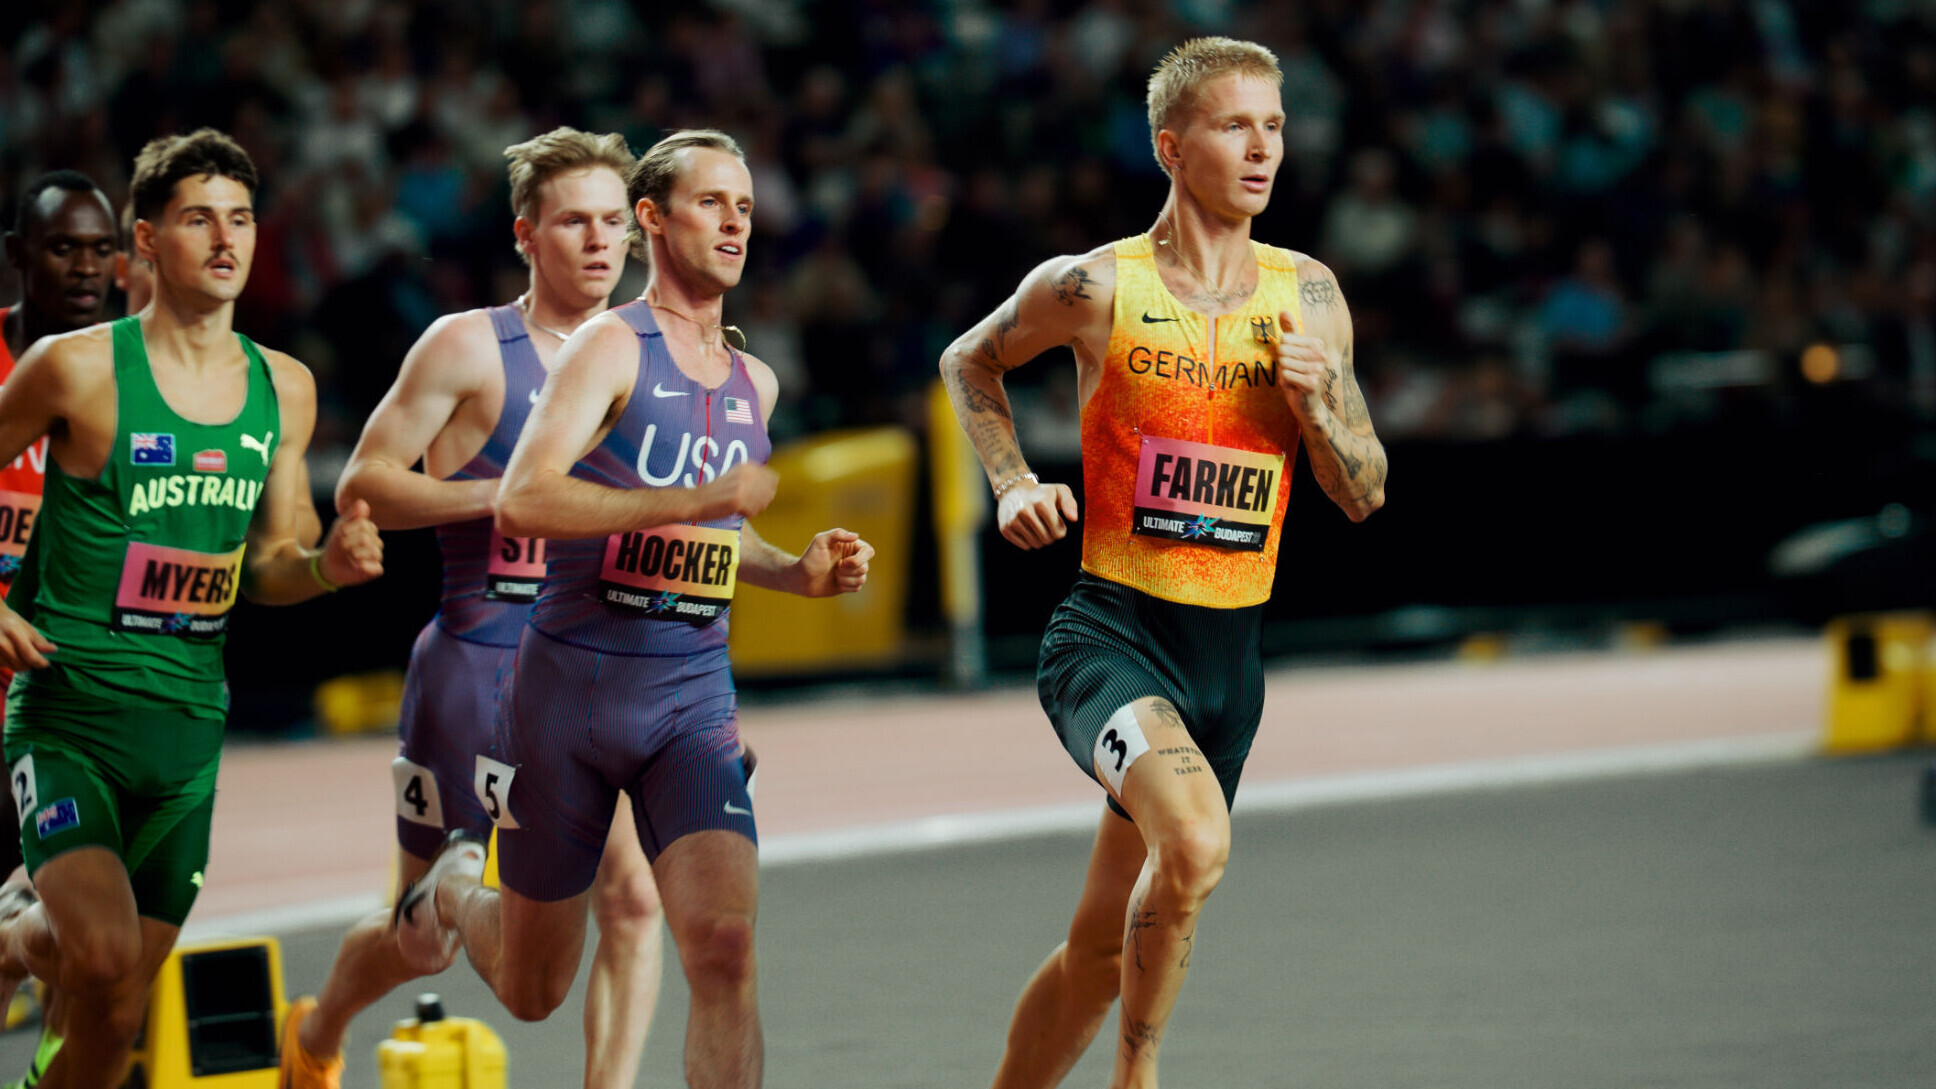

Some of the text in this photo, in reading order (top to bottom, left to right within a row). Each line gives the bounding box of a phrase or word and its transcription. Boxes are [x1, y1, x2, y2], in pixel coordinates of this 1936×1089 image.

[1128, 346, 1276, 390] GERMAN
[637, 423, 748, 489] USA
[1150, 453, 1274, 512] FARKEN
[1143, 515, 1185, 534] ULTIMATE
[1214, 527, 1254, 543] BUDAPEST
[615, 531, 732, 586] HOCKER
[140, 559, 237, 604] MYERS
[607, 588, 650, 609] ULTIMATE
[676, 601, 717, 616] BUDAPEST
[1102, 728, 1127, 772] 3
[15, 771, 33, 816] 2
[404, 775, 428, 817] 4
[485, 772, 500, 820] 5
